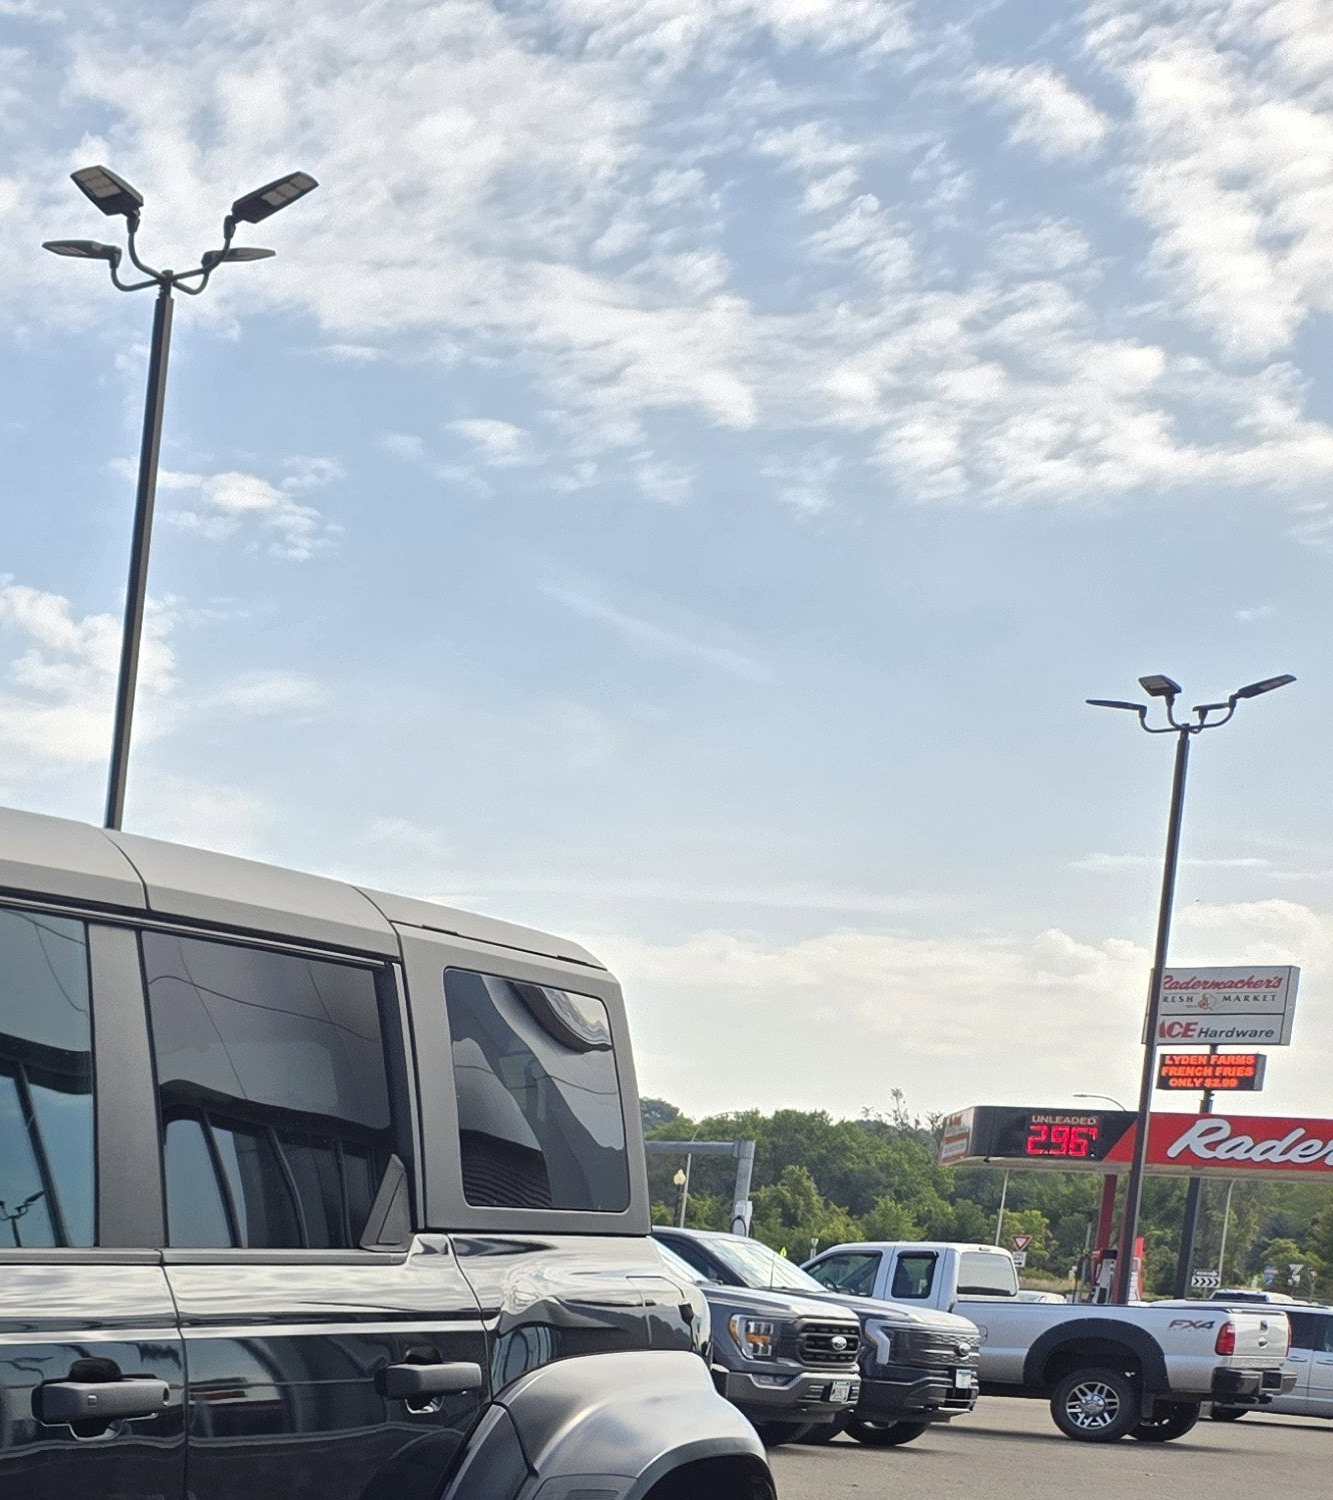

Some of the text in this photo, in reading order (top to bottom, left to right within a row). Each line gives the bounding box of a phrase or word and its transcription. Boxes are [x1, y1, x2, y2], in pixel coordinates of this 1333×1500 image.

[1162, 994, 1277, 1003] RESH MARKET
[1197, 1027, 1274, 1039] Hardware
[1164, 1055, 1255, 1065] LYDEN FARMS
[1161, 1066, 1254, 1077] FRENCH FRIES
[1168, 1078, 1204, 1088] ONLY
[1031, 1115, 1098, 1125] UNLEADED
[1169, 1319, 1216, 1330] FX4
